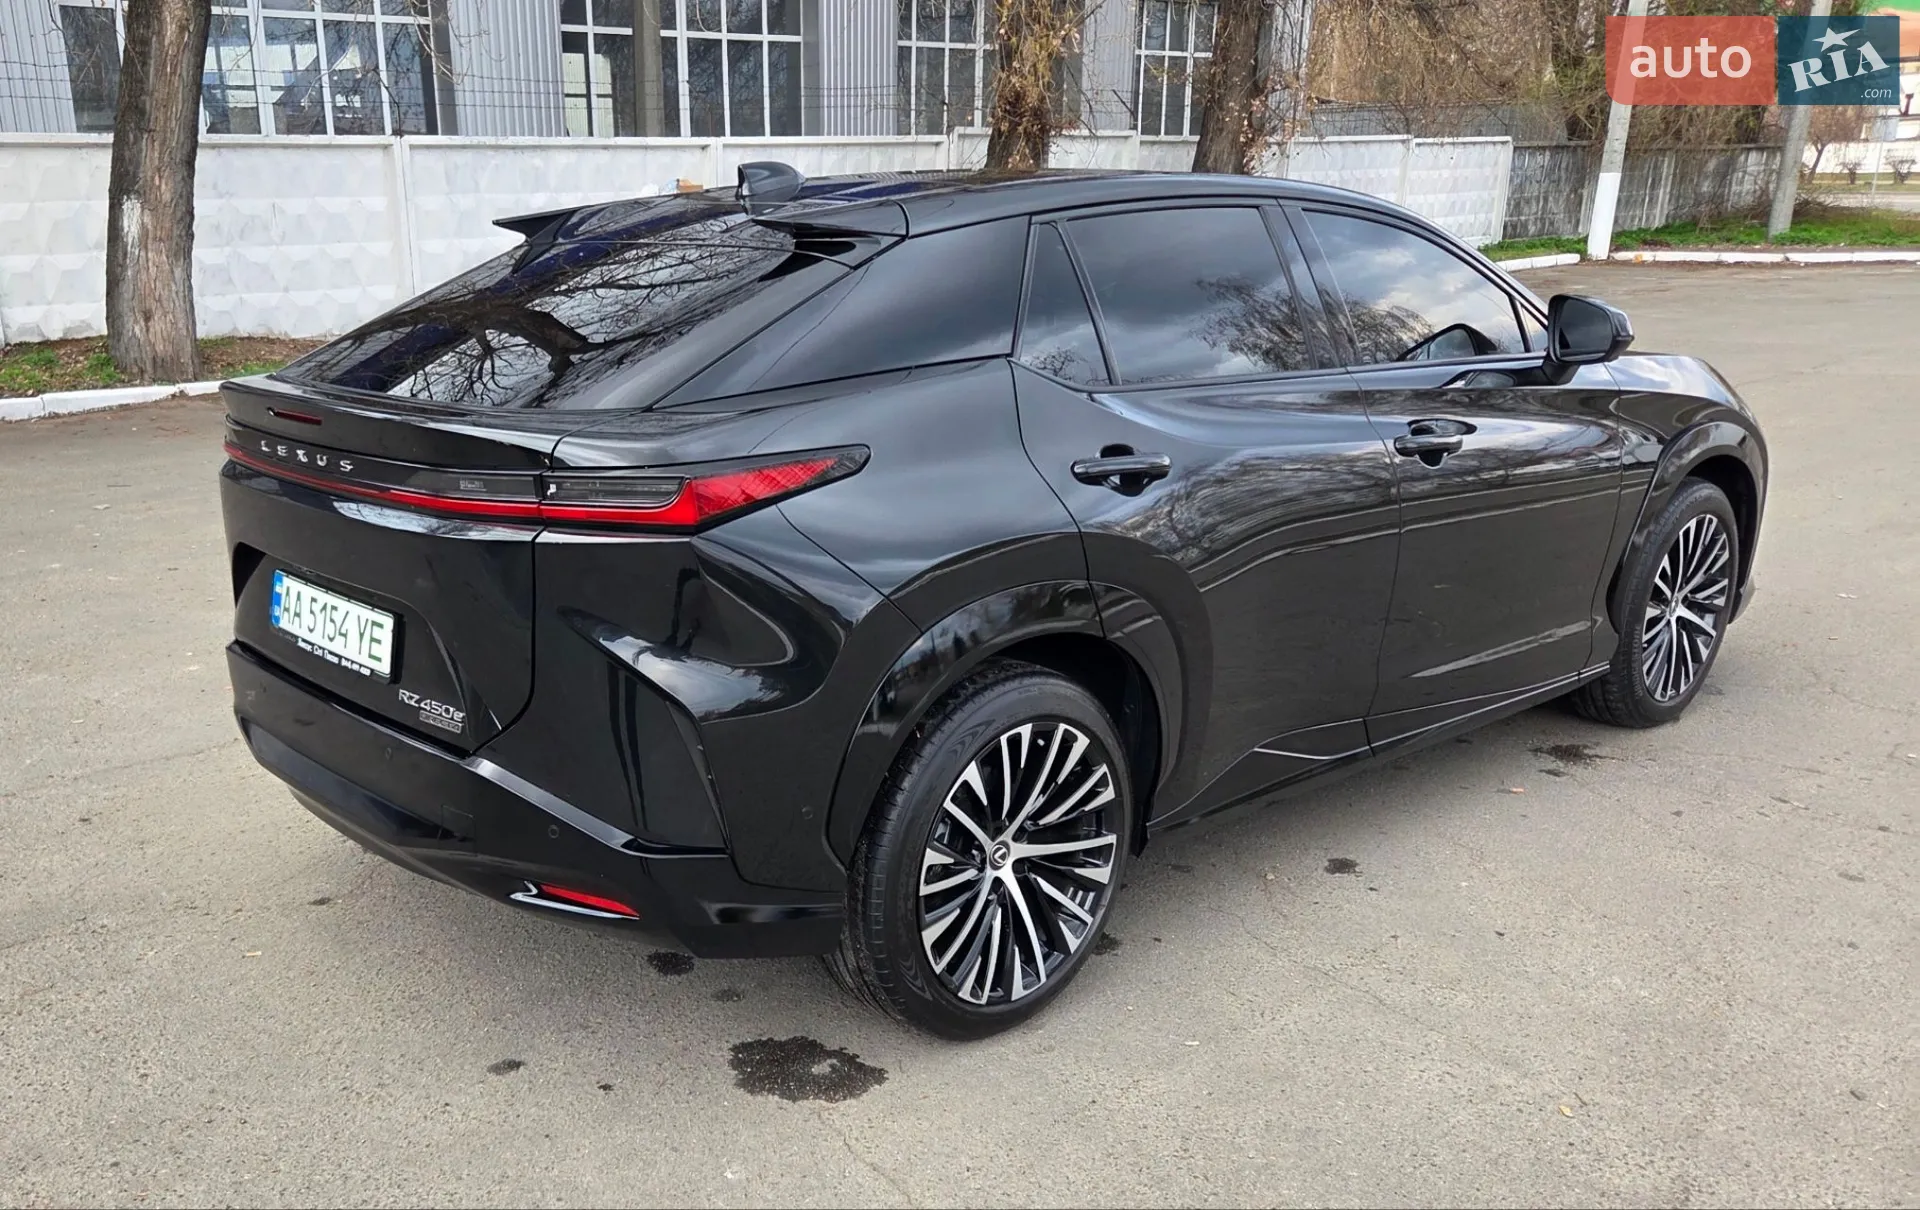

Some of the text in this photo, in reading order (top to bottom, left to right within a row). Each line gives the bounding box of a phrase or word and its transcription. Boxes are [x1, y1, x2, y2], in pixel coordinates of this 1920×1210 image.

[260, 439, 354, 472] LEXUS
[281, 584, 302, 629] AA
[307, 595, 350, 649] 5154
[356, 613, 385, 664] YE
